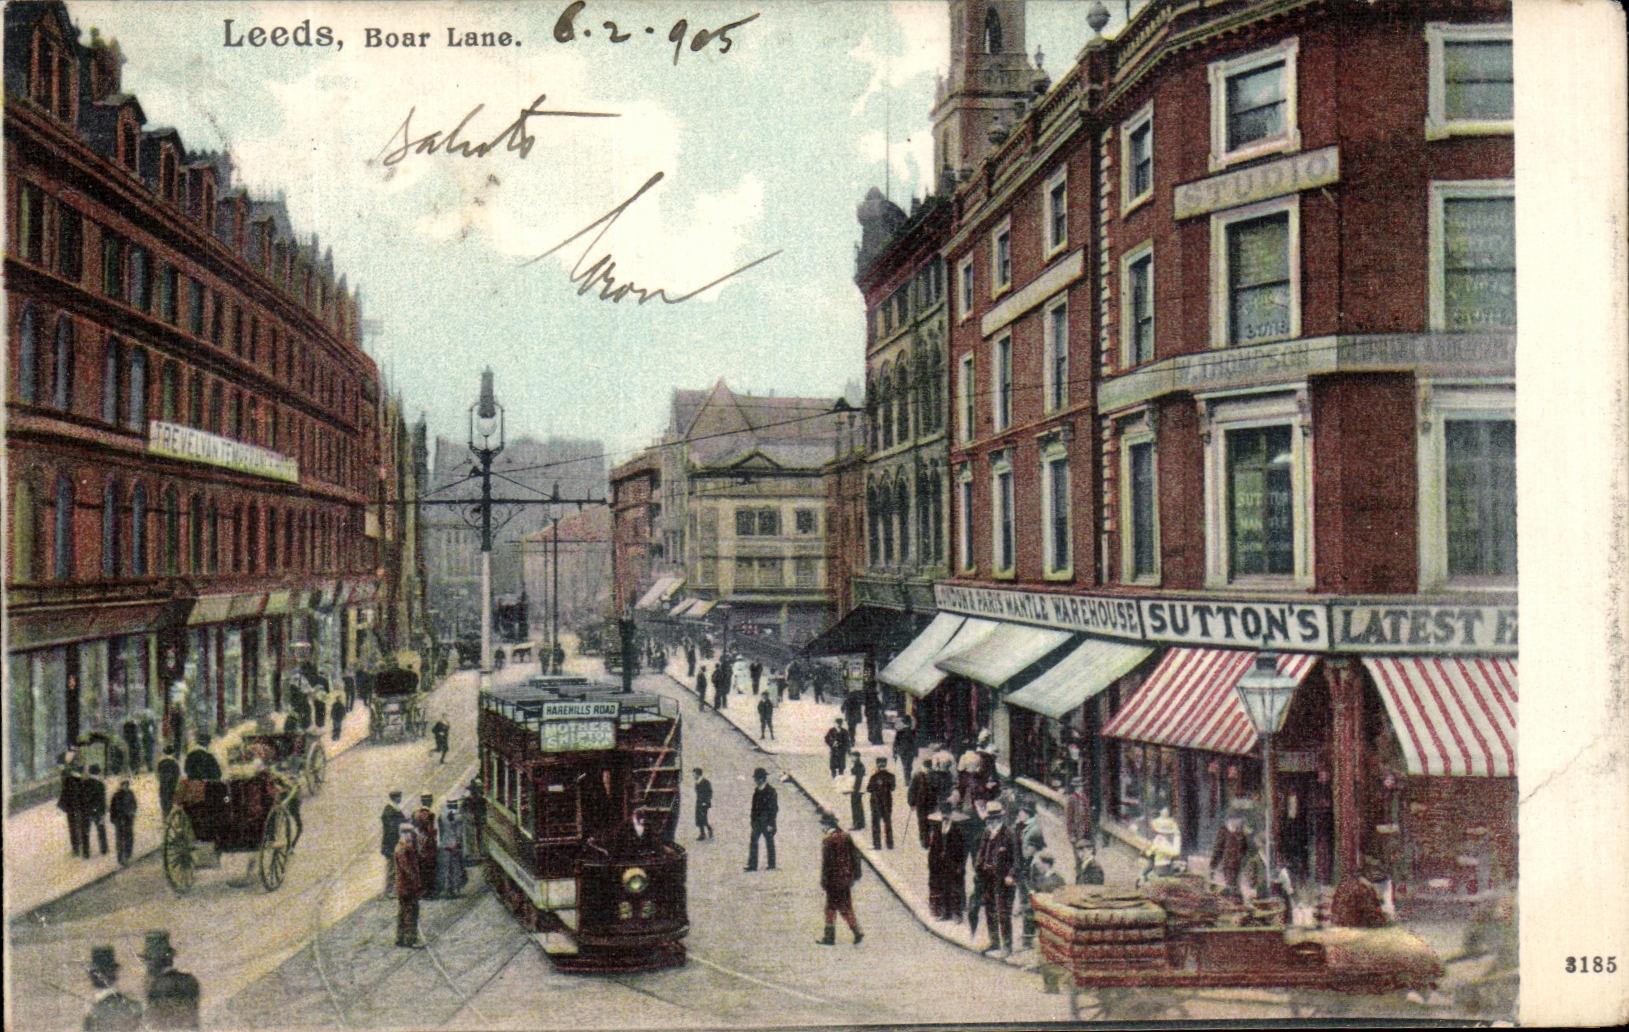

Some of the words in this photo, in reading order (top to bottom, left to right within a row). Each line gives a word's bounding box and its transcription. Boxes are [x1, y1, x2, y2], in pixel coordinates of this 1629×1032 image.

[1183, 155, 1330, 206] STUDIO
[1005, 591, 1049, 620] MANTLE
[1051, 597, 1138, 633] WAREHOUSE
[1148, 603, 1320, 642] SUTTON'S
[1341, 608, 1484, 645] LATEST
[546, 704, 591, 715] HAREHILLS
[593, 704, 616, 715] ROAD
